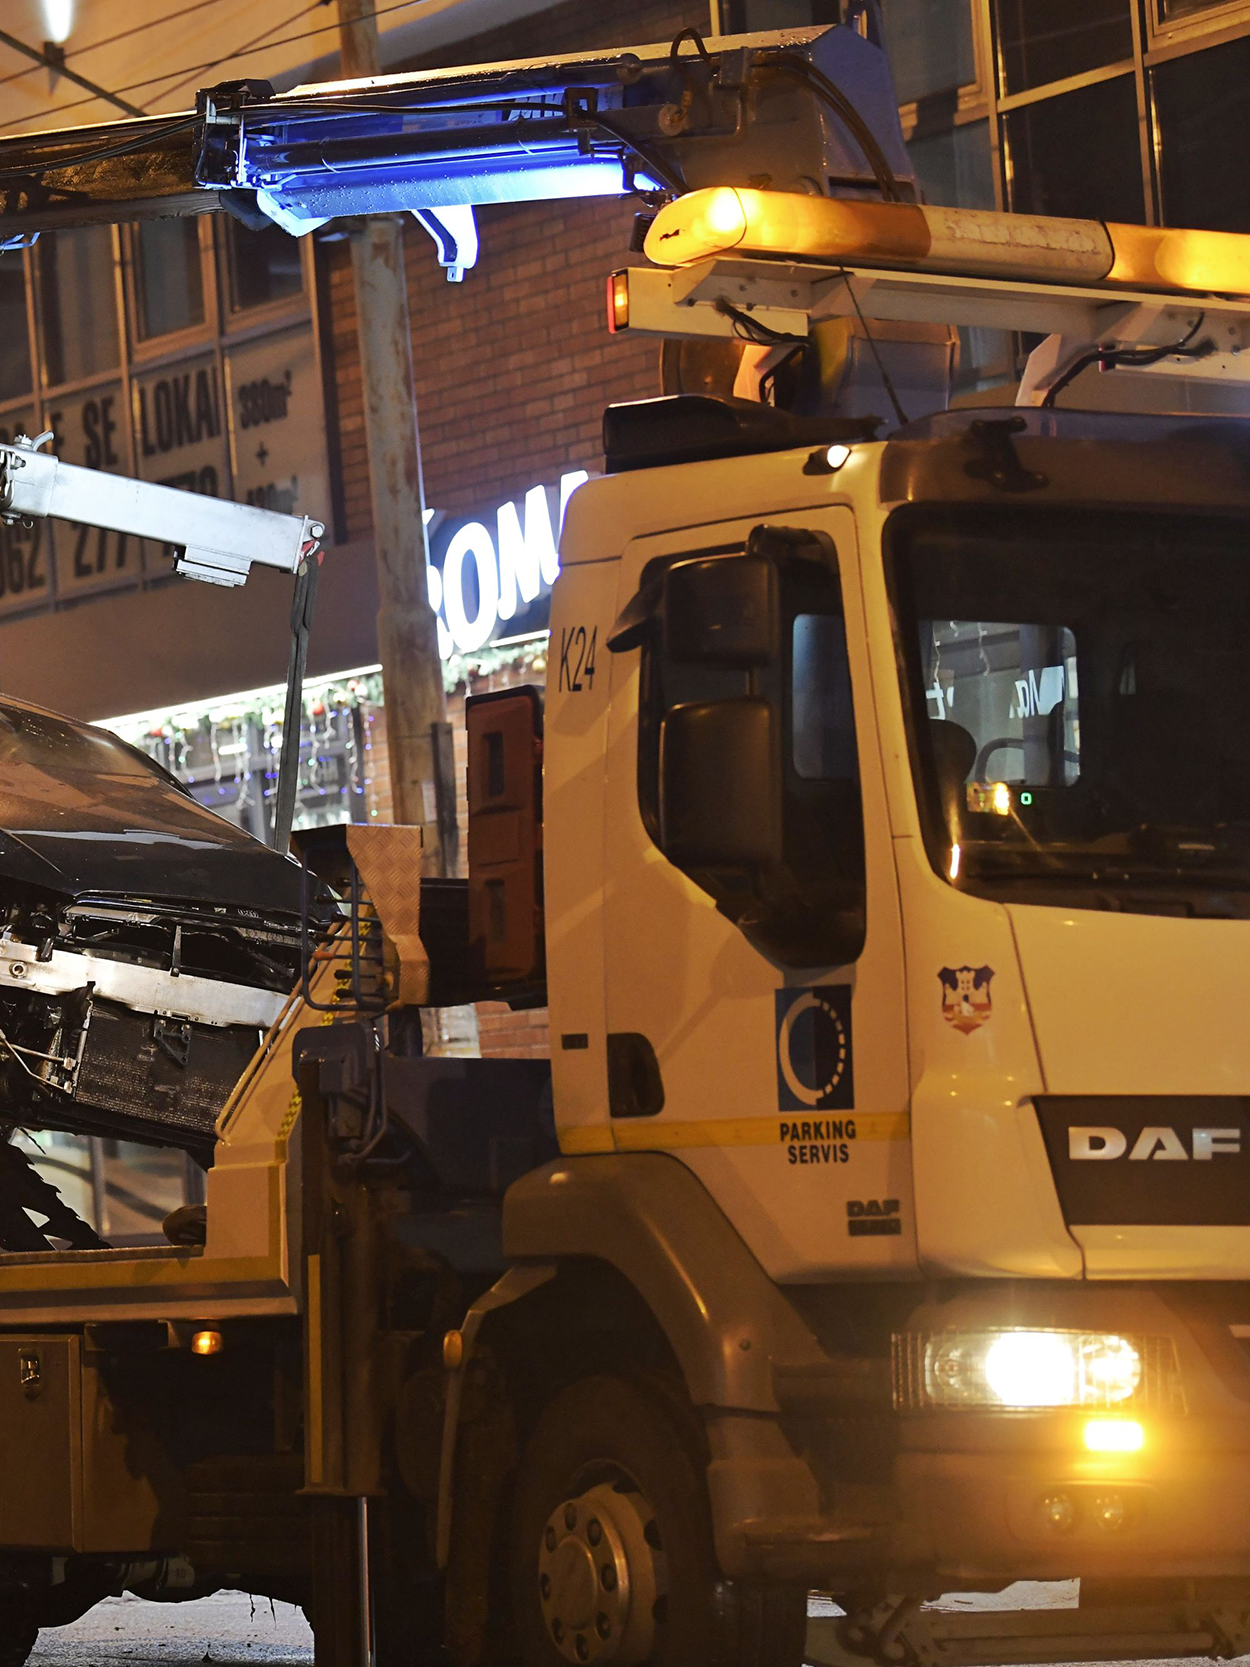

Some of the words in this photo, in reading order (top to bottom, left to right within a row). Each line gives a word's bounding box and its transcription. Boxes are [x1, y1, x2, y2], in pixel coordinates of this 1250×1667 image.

[559, 625, 598, 692] K24
[780, 1120, 857, 1142] PARKING
[787, 1143, 850, 1165] SERVIS
[1068, 1126, 1241, 1161] DAF
[846, 1198, 900, 1218] DAF
